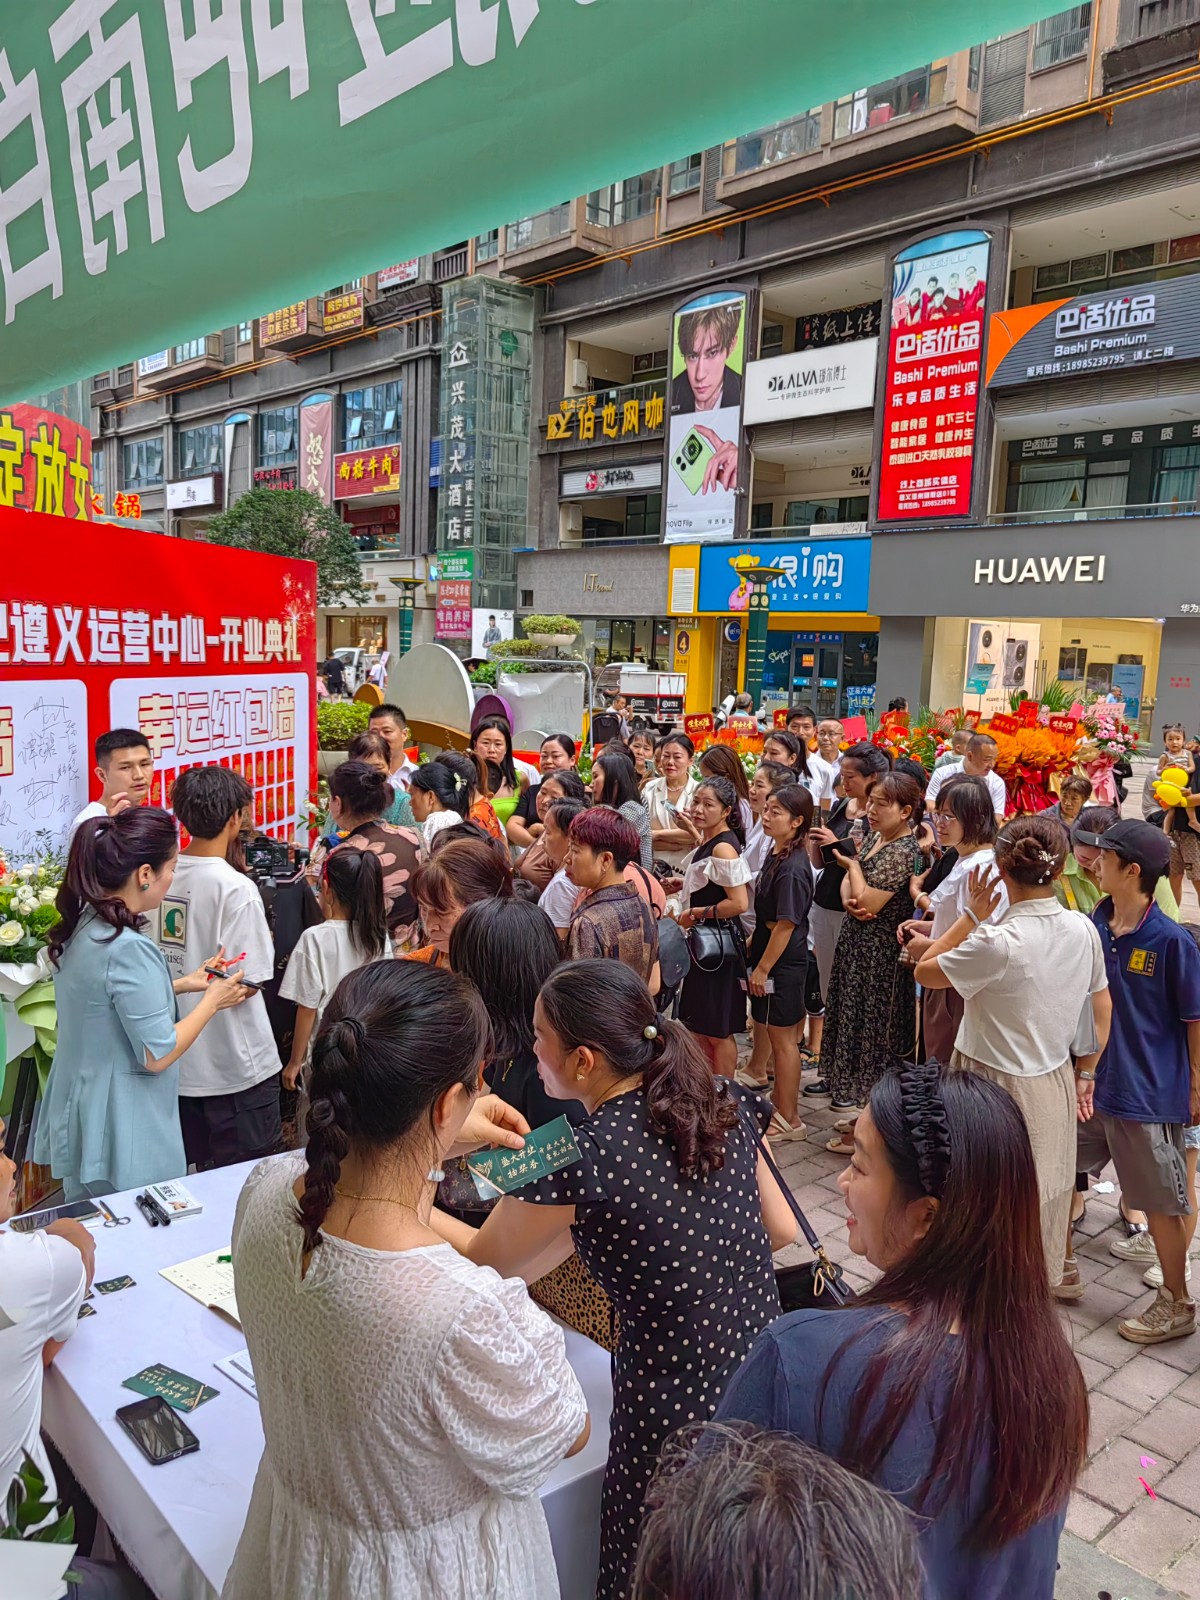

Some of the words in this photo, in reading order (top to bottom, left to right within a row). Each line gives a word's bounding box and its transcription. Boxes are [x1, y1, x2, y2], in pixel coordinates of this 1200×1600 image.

[823, 310, 882, 341] 纸上佳
[1054, 341, 1088, 357] Bashi
[1090, 333, 1147, 351] Premium
[1133, 347, 1174, 361] 请上二楼
[894, 368, 923, 385] Bashi
[927, 360, 978, 379] Premium
[892, 381, 977, 407] 乐享品质生活
[578, 391, 665, 440] 伯也网咖
[974, 555, 1106, 584] HUAWEI
[0, 599, 302, 665] 遵义运营中心-开业典礼
[680, 637, 687, 651] 4
[138, 685, 296, 760] 幸运红包墙
[501, 1144, 537, 1167] 盛大开业
[507, 1159, 539, 1179] 抽奖券
